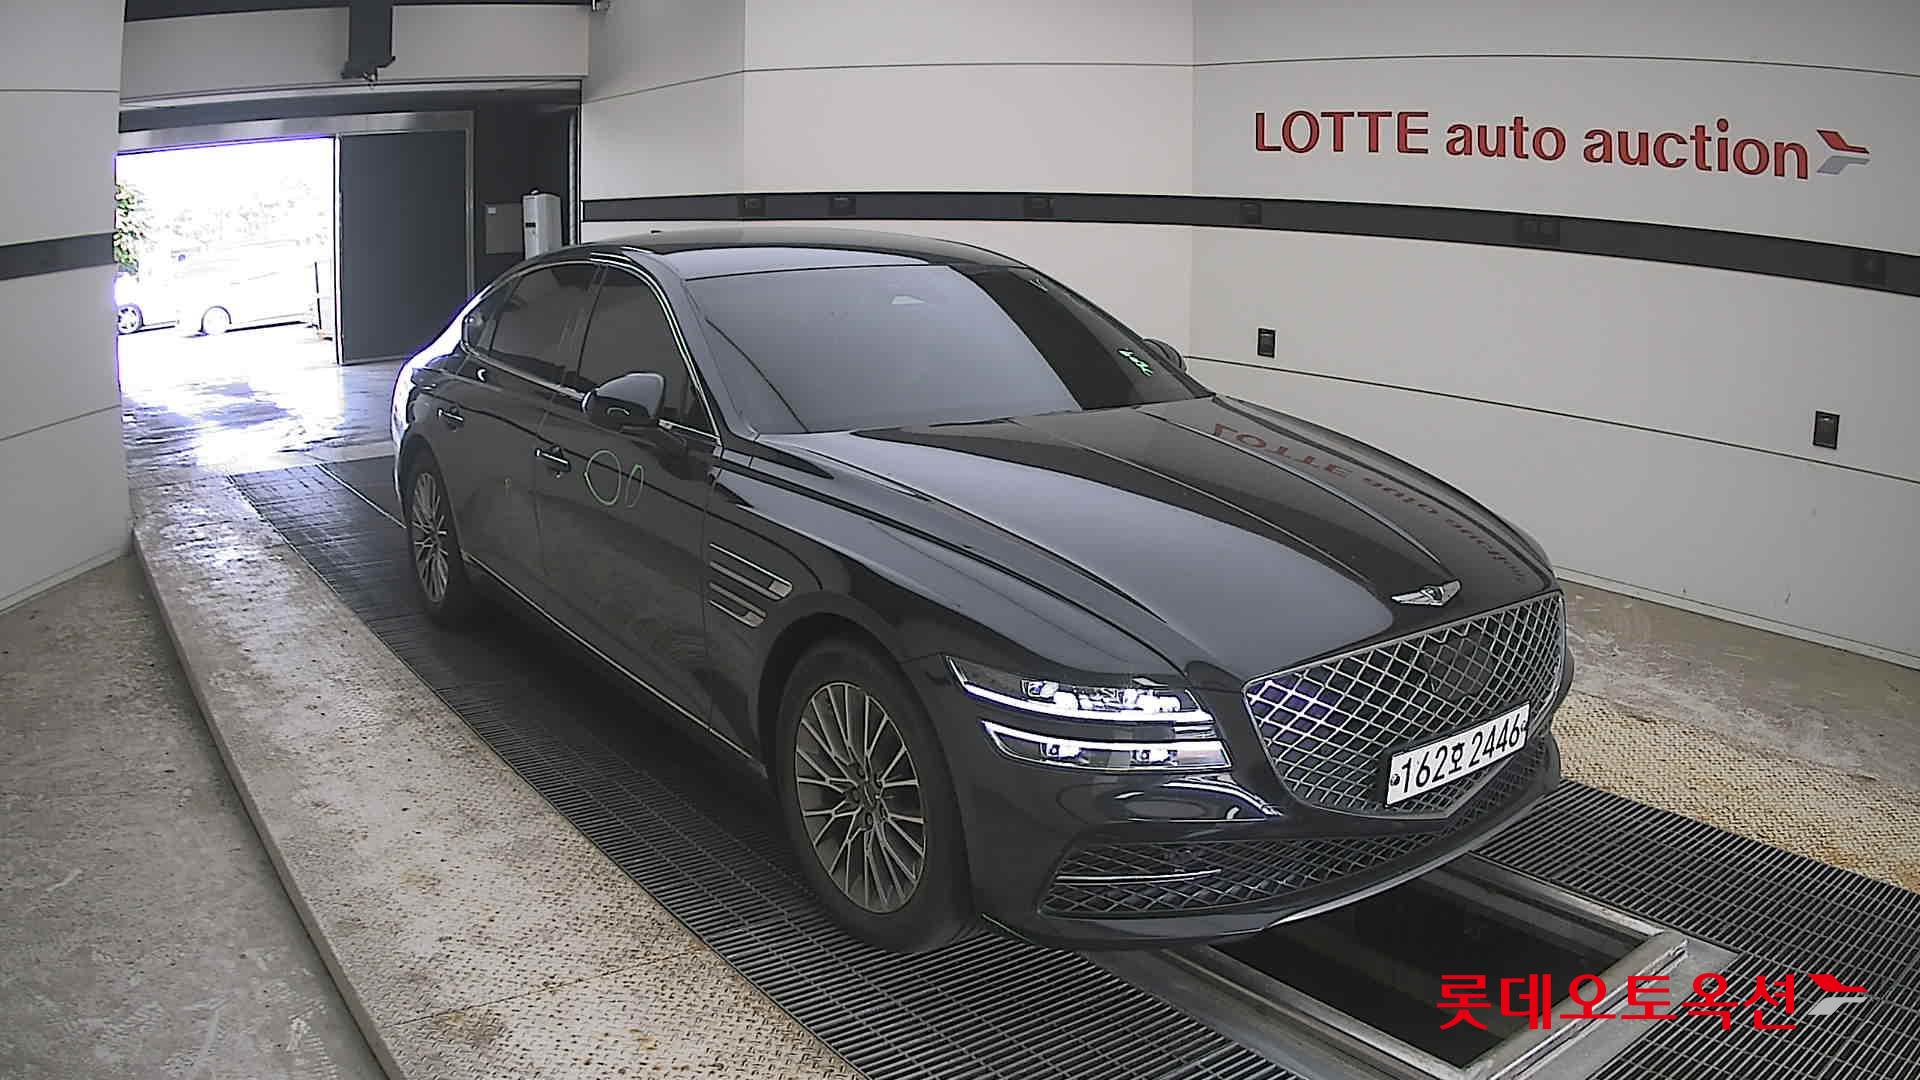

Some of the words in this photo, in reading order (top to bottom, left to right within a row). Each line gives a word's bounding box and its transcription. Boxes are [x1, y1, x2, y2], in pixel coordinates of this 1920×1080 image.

[1255, 110, 1429, 155] LOTTE
[1446, 116, 1567, 161] auto
[1583, 118, 1809, 180] auction
[1468, 713, 1521, 768] 2446
